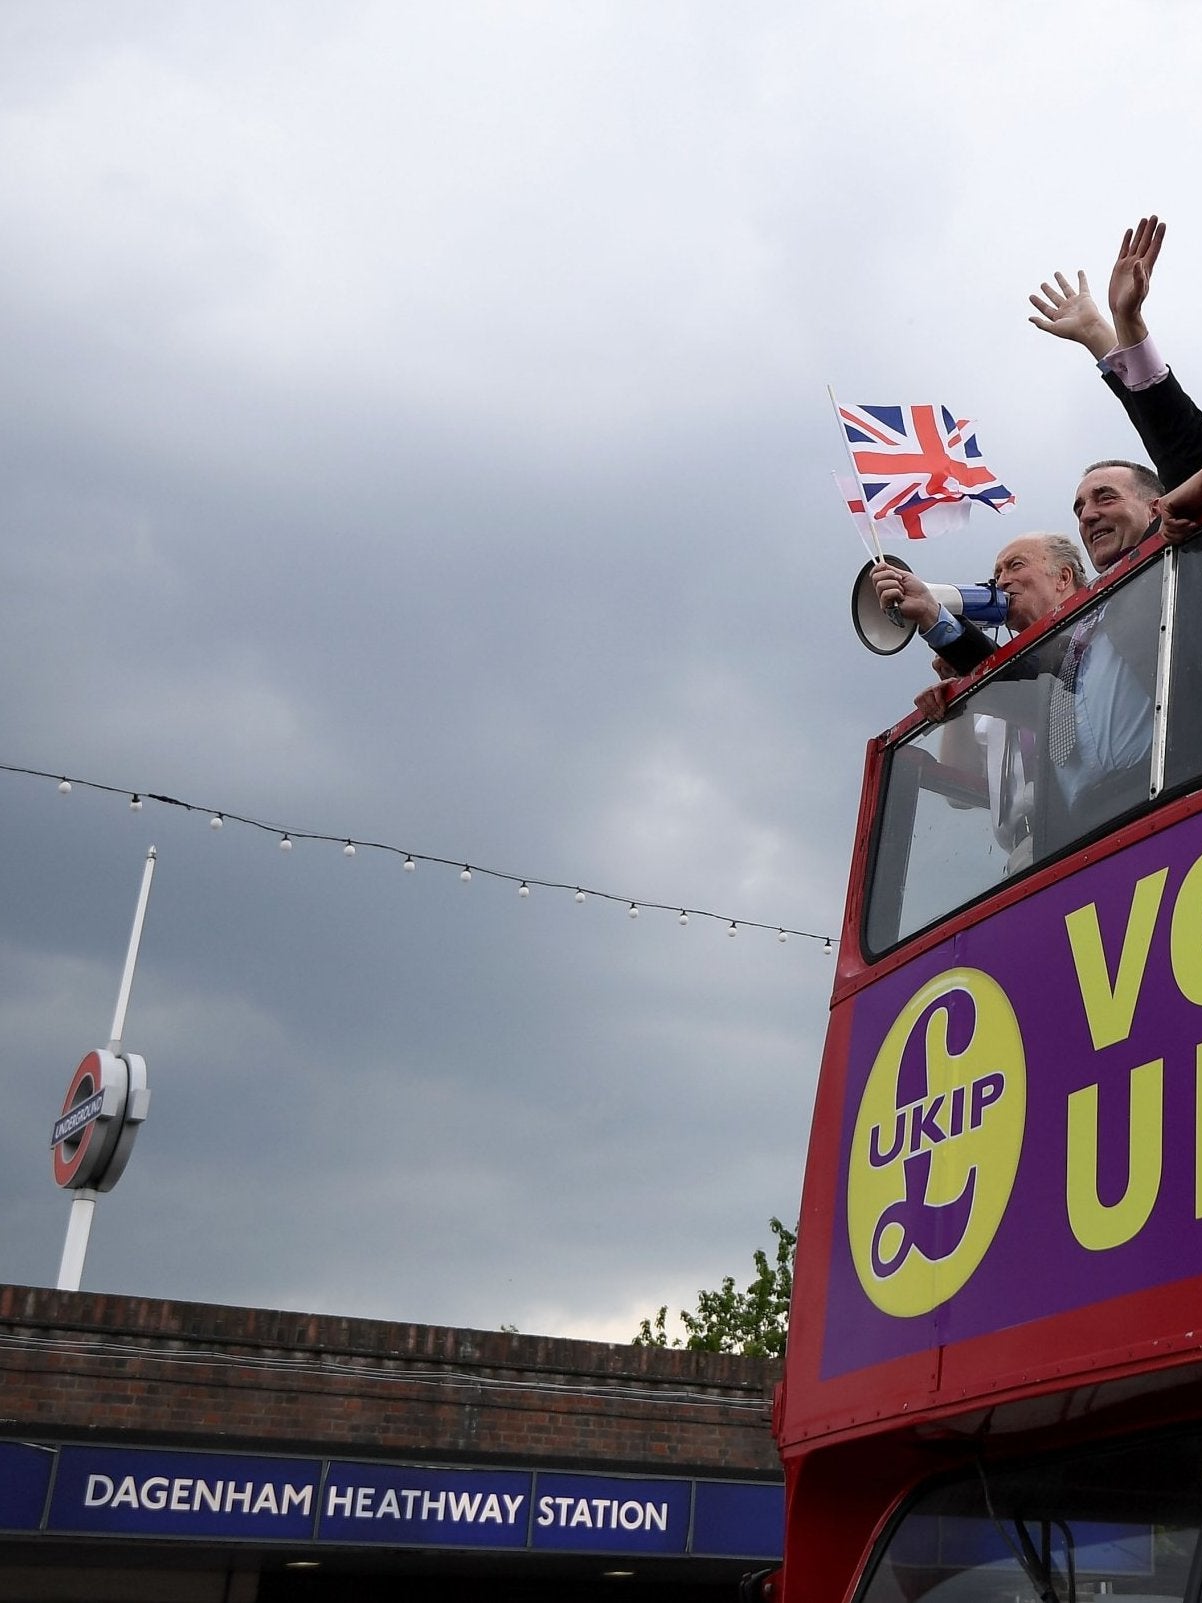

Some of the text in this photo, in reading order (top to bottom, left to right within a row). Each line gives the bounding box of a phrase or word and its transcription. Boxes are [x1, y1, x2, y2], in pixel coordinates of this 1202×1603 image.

[55, 1096, 103, 1139] UNDERGROUND
[869, 1071, 1006, 1169] UKIP
[84, 1474, 668, 1531] DAGENHAM HEATHWAY STATION
